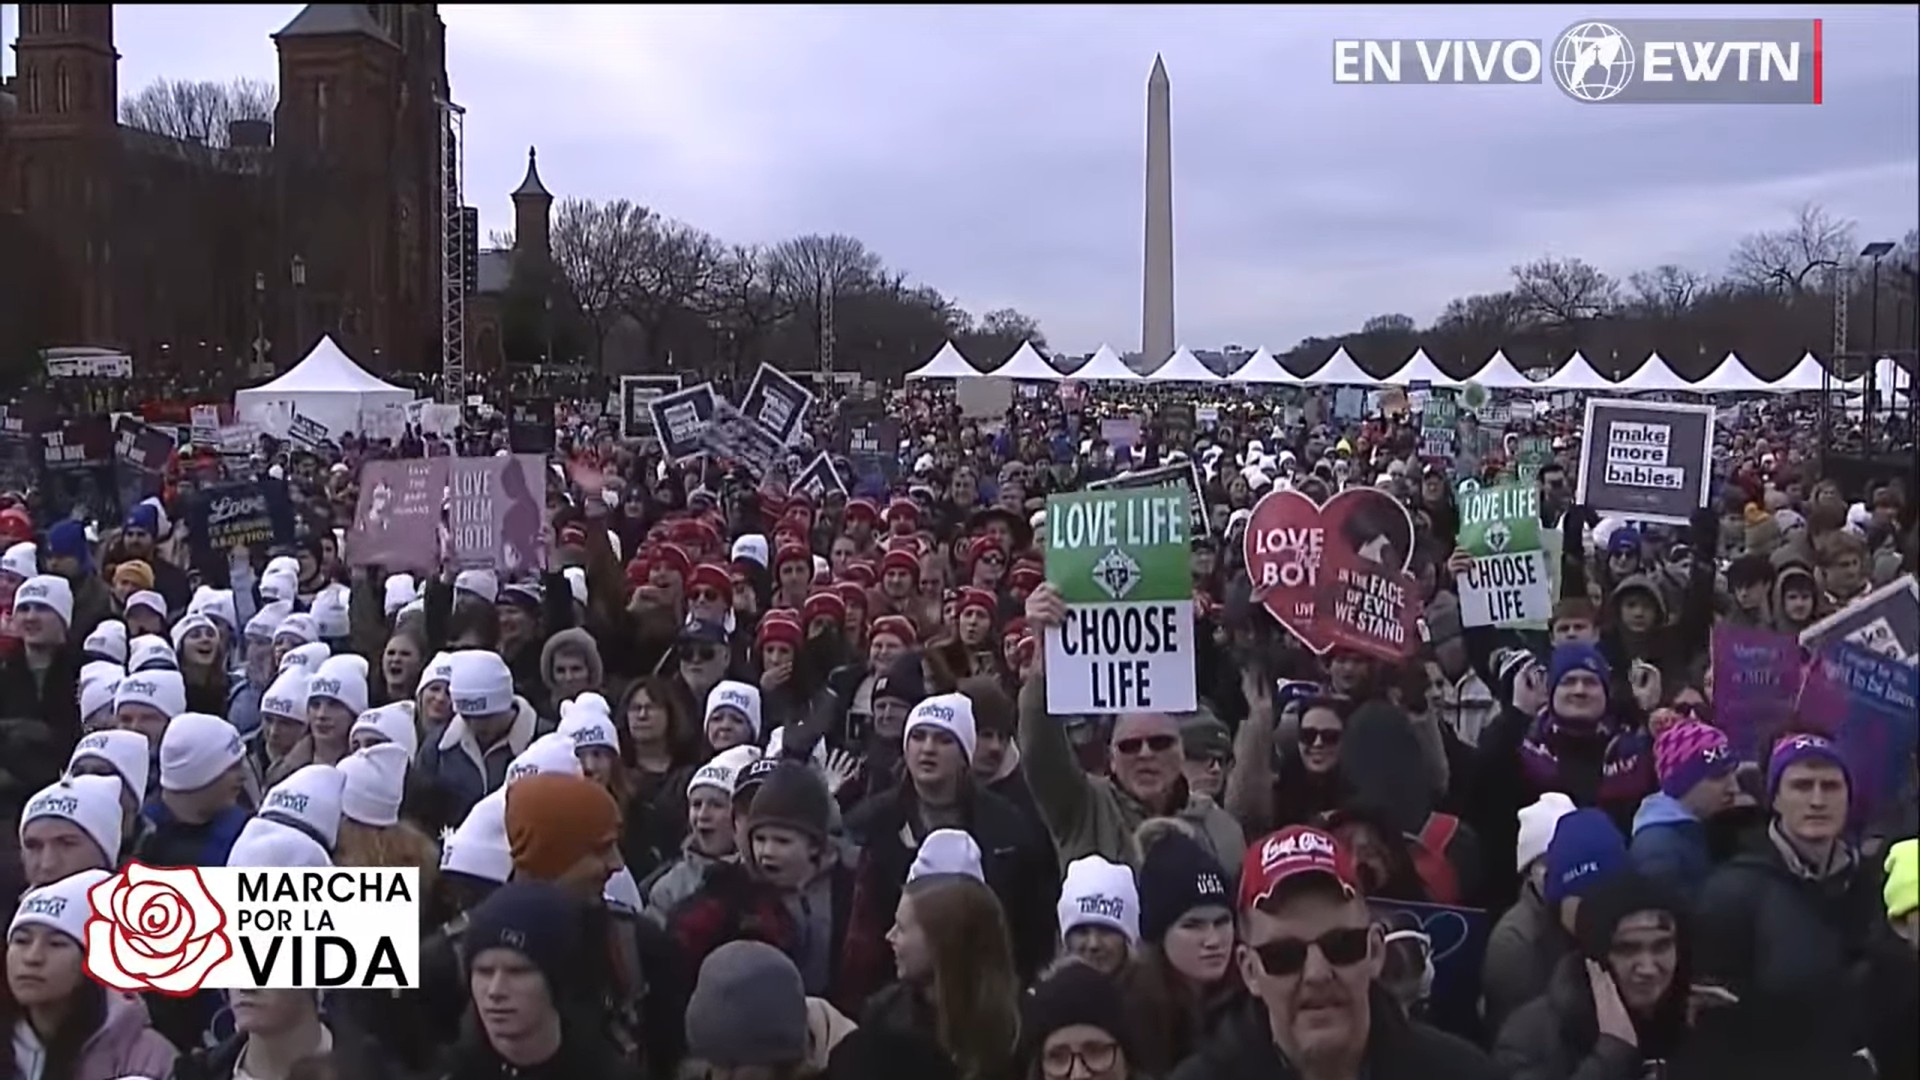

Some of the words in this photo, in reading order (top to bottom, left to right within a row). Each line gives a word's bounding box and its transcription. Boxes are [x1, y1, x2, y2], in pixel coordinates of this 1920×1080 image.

[1612, 425, 1666, 443] make
[1610, 447, 1664, 461] more
[454, 470, 490, 497] LOVE
[1607, 464, 1680, 486] babies.
[208, 495, 266, 524] Love
[455, 498, 493, 524] THEM
[1464, 493, 1500, 526] LOVE
[1503, 487, 1537, 519] LIFE
[454, 524, 493, 550] BOTH
[1053, 498, 1118, 549] LOVE
[1126, 497, 1183, 546] LIFE
[211, 530, 275, 549] ABORTION
[1256, 527, 1324, 554] LOVE
[1467, 553, 1537, 590] CHOOSE
[1338, 566, 1350, 581] IN
[1350, 569, 1368, 588] THE
[1369, 573, 1405, 608] FACE
[1346, 589, 1361, 605] OF
[1362, 595, 1399, 620] EVIL
[1487, 589, 1525, 623] LIFE
[1061, 606, 1178, 656] CHOOSE
[1334, 600, 1355, 625] WE
[1356, 611, 1405, 644] STAND
[1091, 660, 1151, 709] LIFE
[1852, 668, 1867, 689] to
[1867, 674, 1885, 698] be
[1197, 881, 1225, 895] USA
